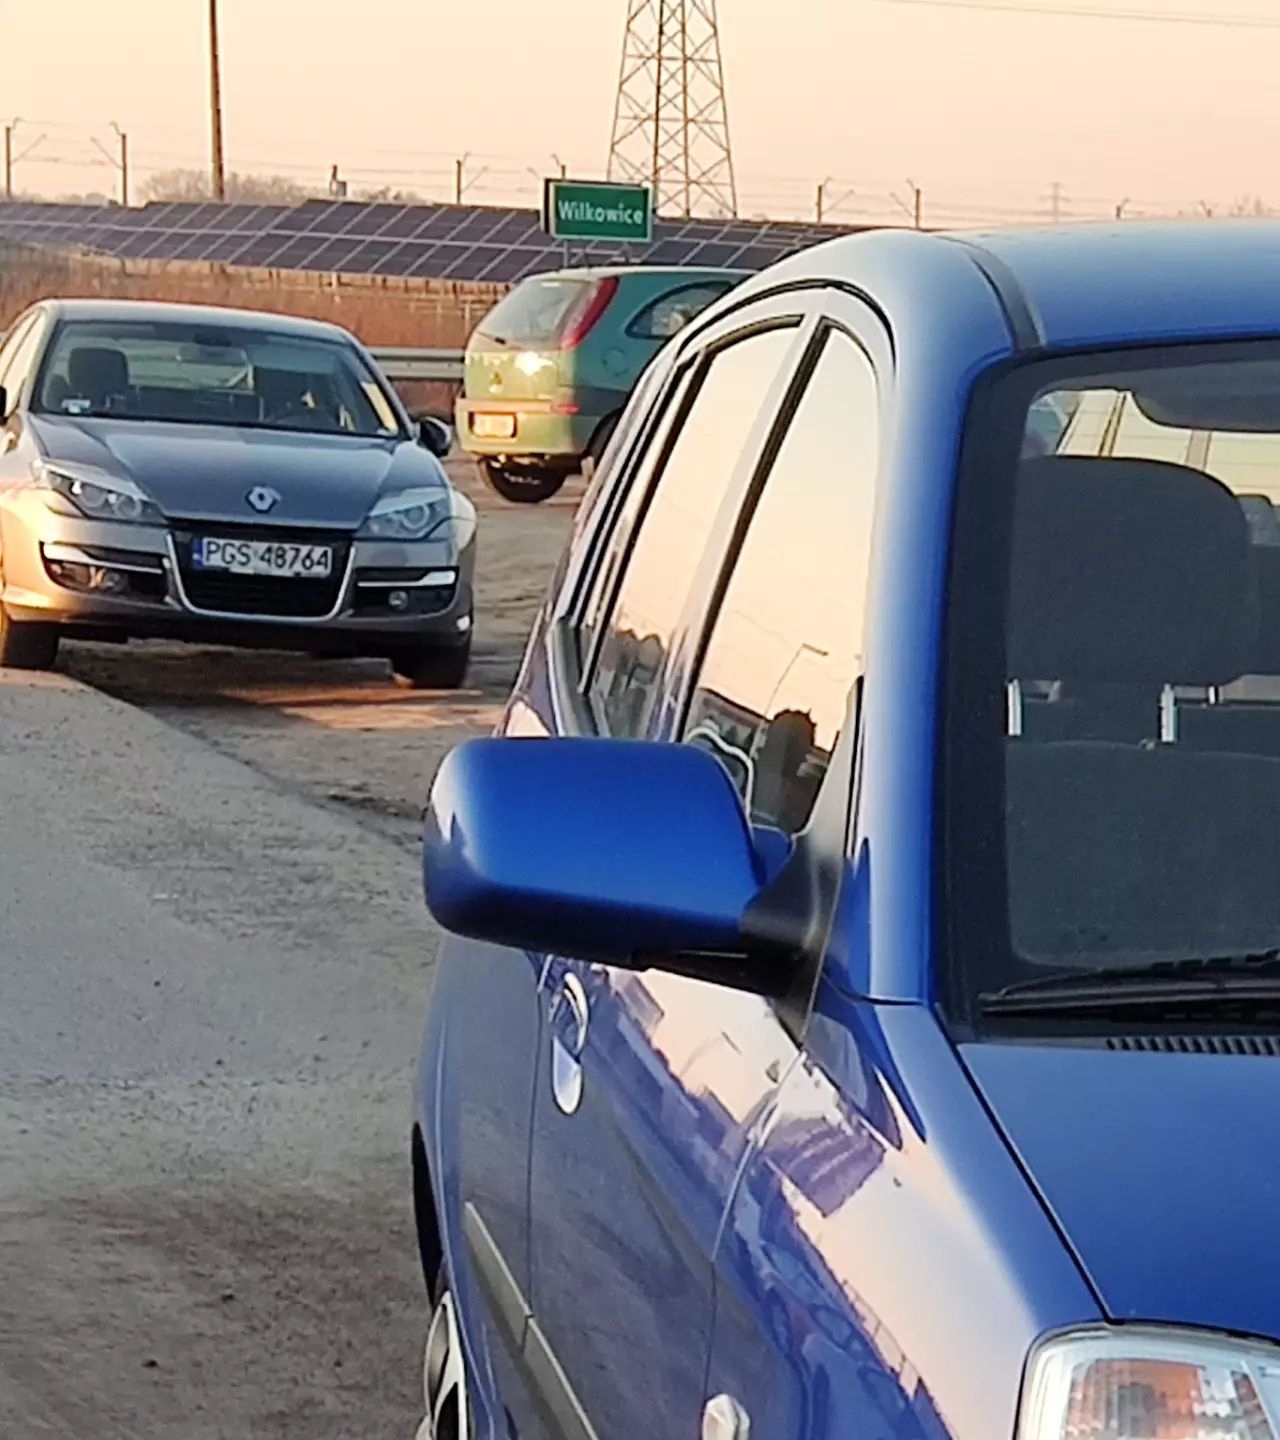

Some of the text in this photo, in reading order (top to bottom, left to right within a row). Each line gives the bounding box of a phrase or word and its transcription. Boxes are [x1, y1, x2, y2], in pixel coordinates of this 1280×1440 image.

[558, 199, 644, 225] Wilkowice
[206, 540, 330, 571] PGS 48764
